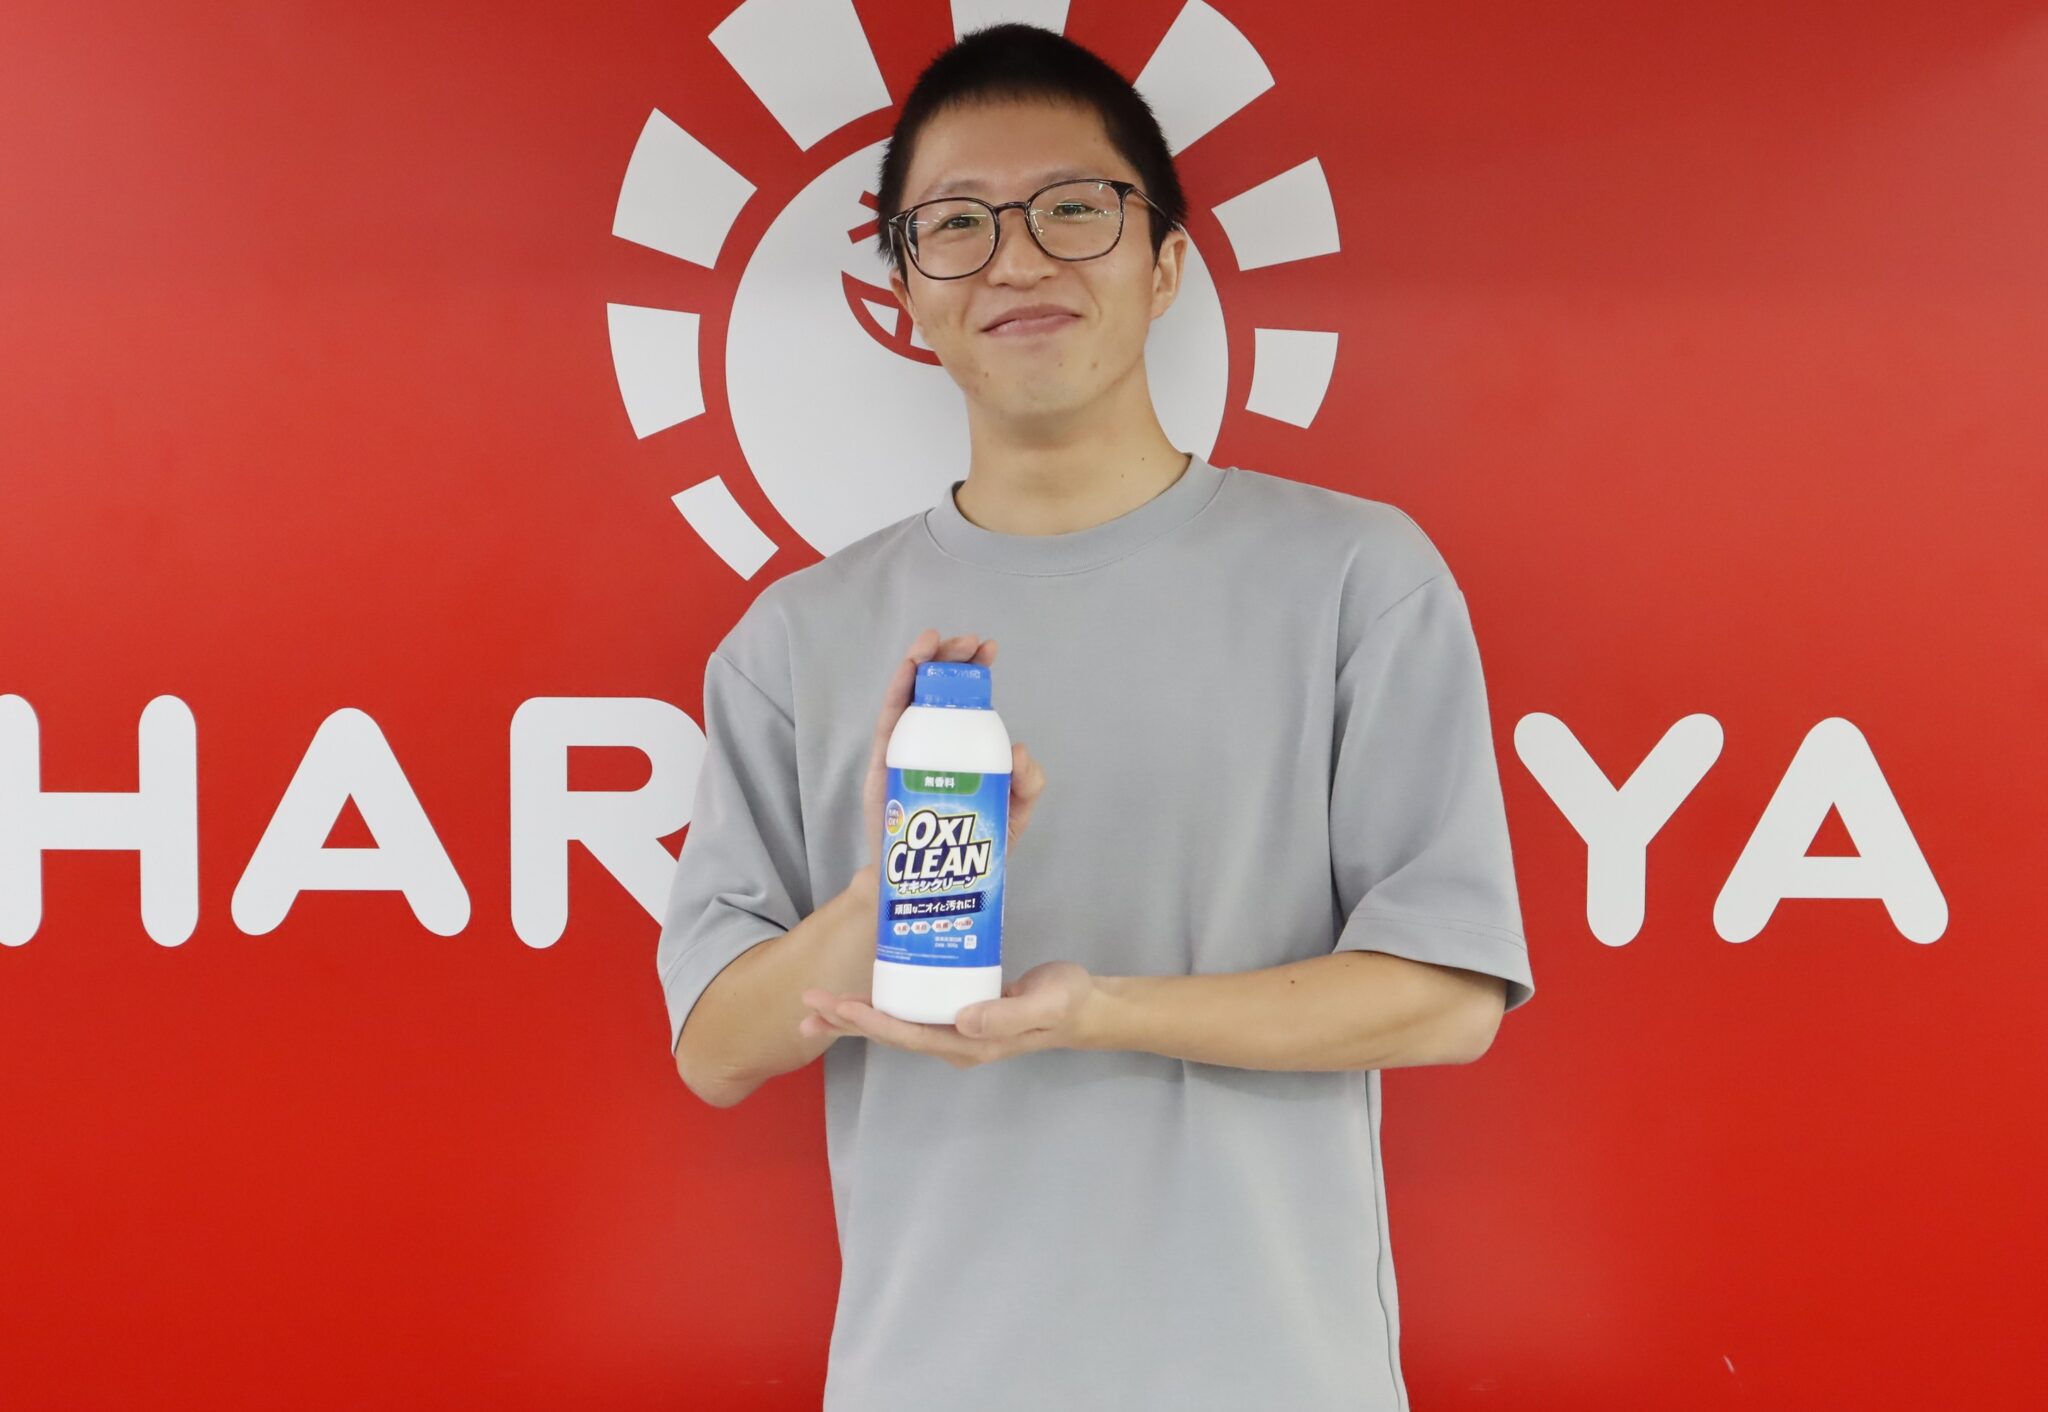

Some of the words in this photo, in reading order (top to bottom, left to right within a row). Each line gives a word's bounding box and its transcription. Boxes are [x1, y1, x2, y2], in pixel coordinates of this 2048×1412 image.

[924, 776, 955, 788] 無香料
[906, 810, 976, 850] OXI
[887, 840, 991, 884] CLEAN
[898, 876, 977, 894] オキシクリーン
